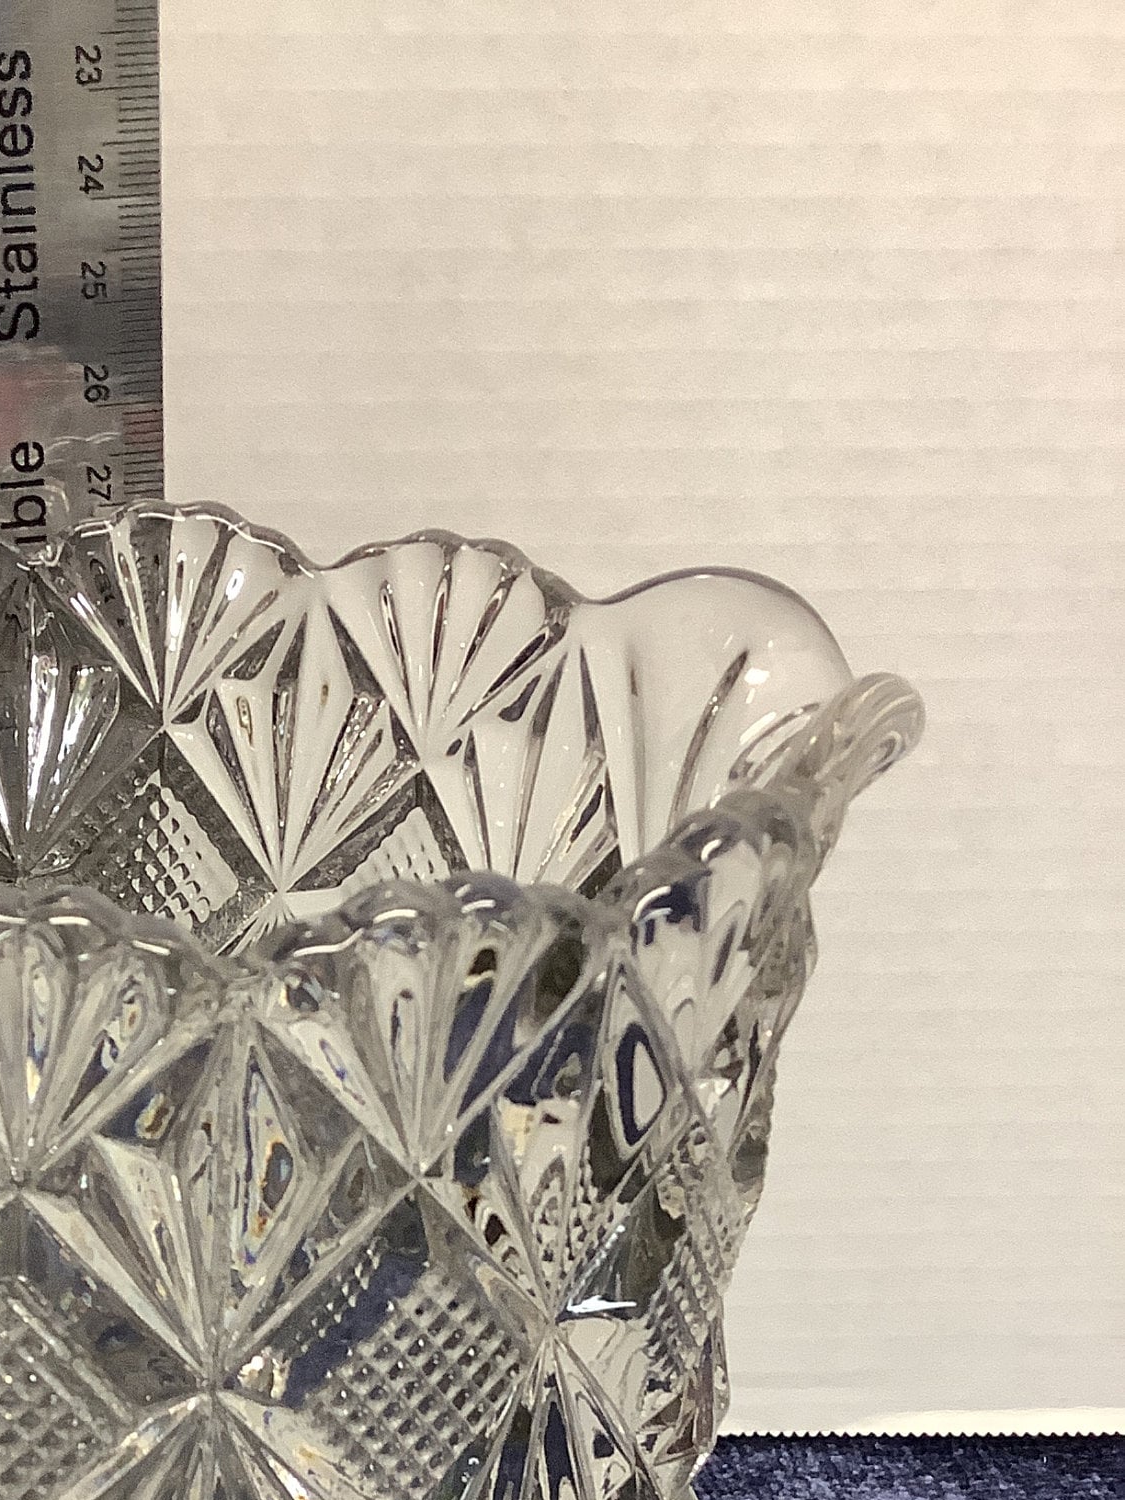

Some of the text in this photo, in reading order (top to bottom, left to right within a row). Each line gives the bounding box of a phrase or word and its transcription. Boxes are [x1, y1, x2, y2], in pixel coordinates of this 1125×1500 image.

[75, 45, 112, 501] 23 24 25 26 27
